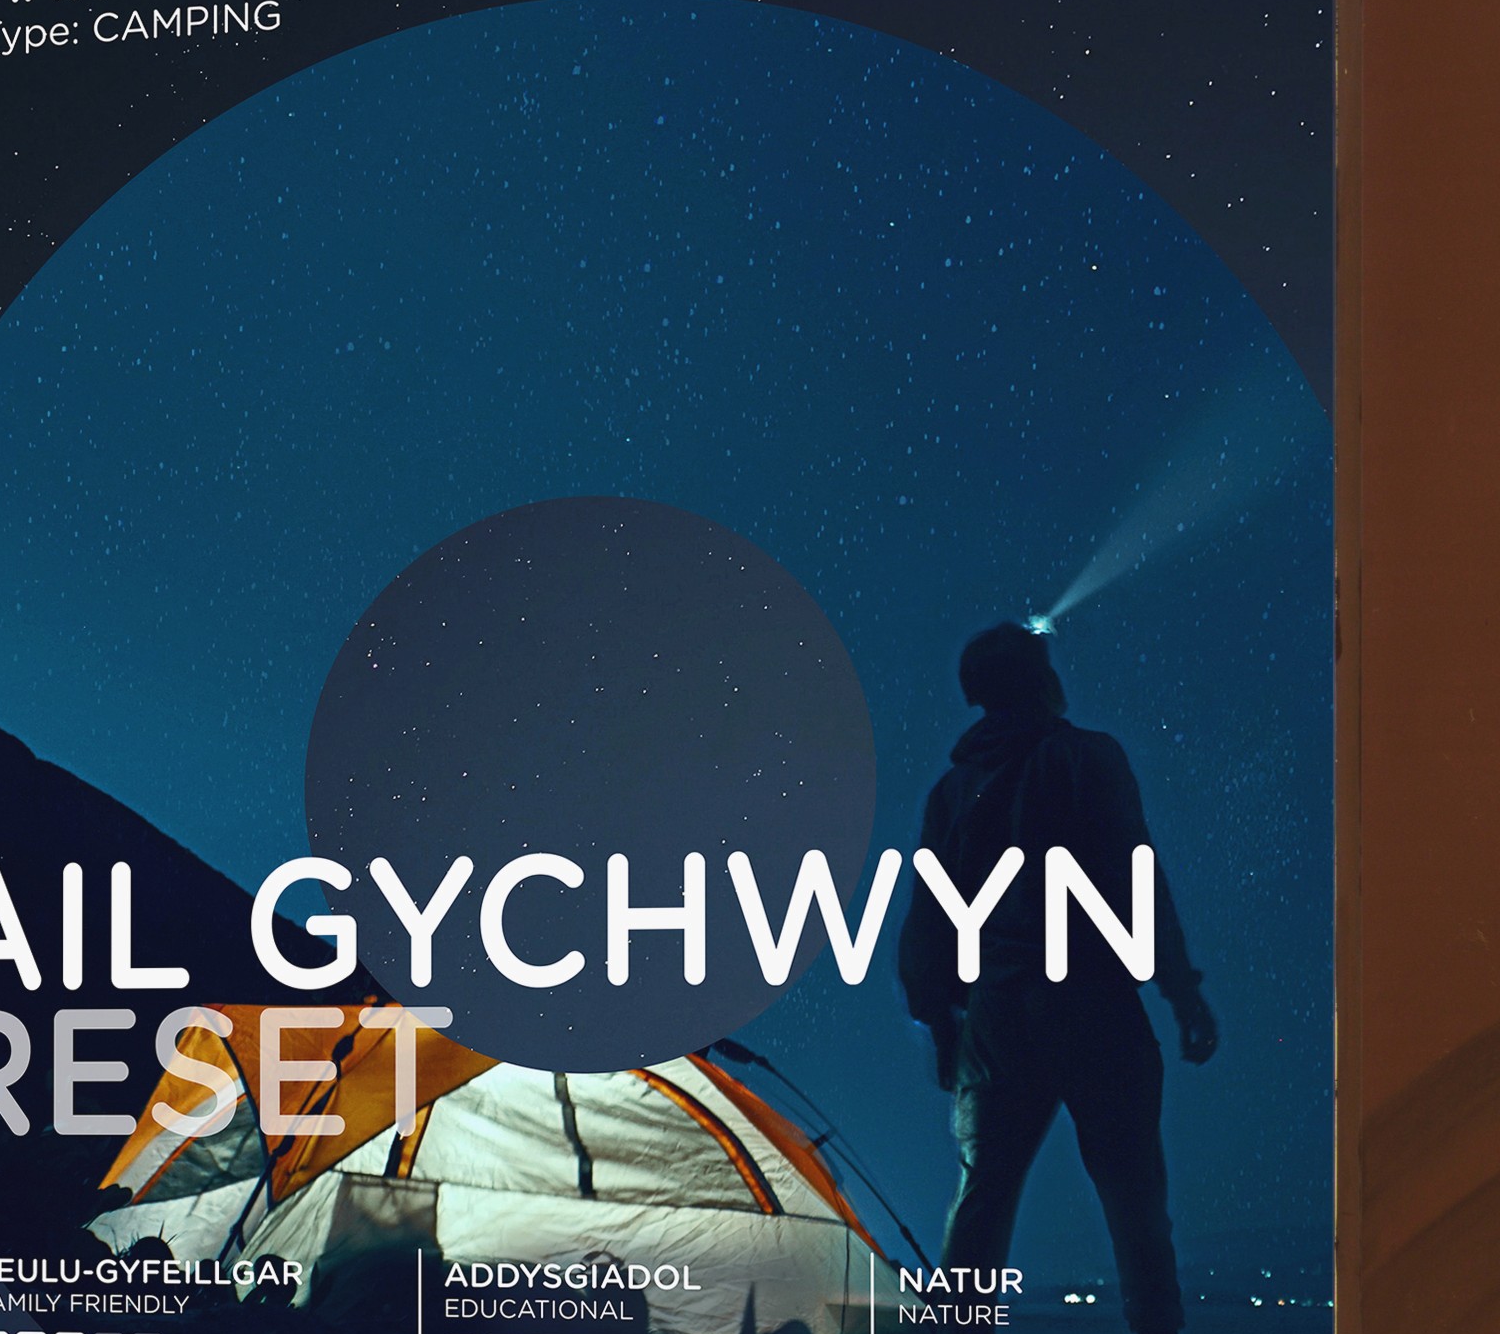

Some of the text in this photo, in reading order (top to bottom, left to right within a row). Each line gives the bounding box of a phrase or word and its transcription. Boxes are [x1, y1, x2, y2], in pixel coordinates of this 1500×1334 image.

[93, 0, 281, 43] CAMPING
[250, 844, 1156, 990] GYCHWYN
[444, 1262, 702, 1292] ADDYSGIADOL
[899, 1268, 1024, 1296] NATUR
[71, 1293, 190, 1316] FRIENDLY
[444, 1298, 634, 1322] EDUCATIONAL
[899, 1302, 1011, 1327] NATURE
